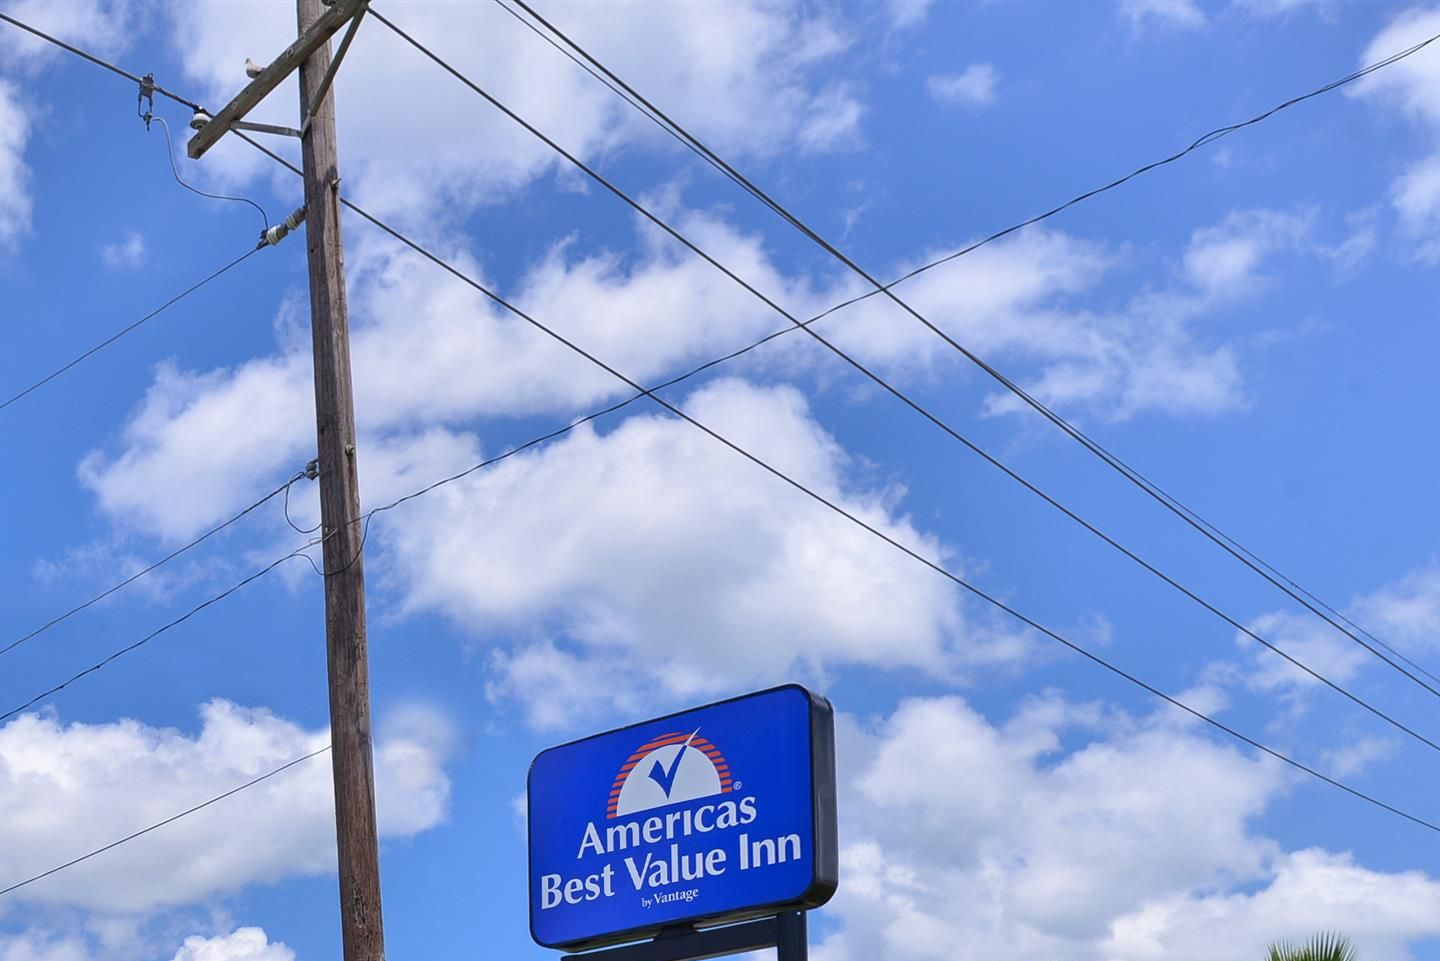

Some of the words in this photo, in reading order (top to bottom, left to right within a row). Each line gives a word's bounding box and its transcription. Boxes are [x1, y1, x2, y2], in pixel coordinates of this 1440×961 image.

[576, 796, 757, 859] Americas
[541, 862, 615, 910] Best
[624, 843, 727, 891] Value
[739, 833, 802, 871] Inn
[641, 897, 653, 909] by
[653, 888, 699, 904] Vantage
